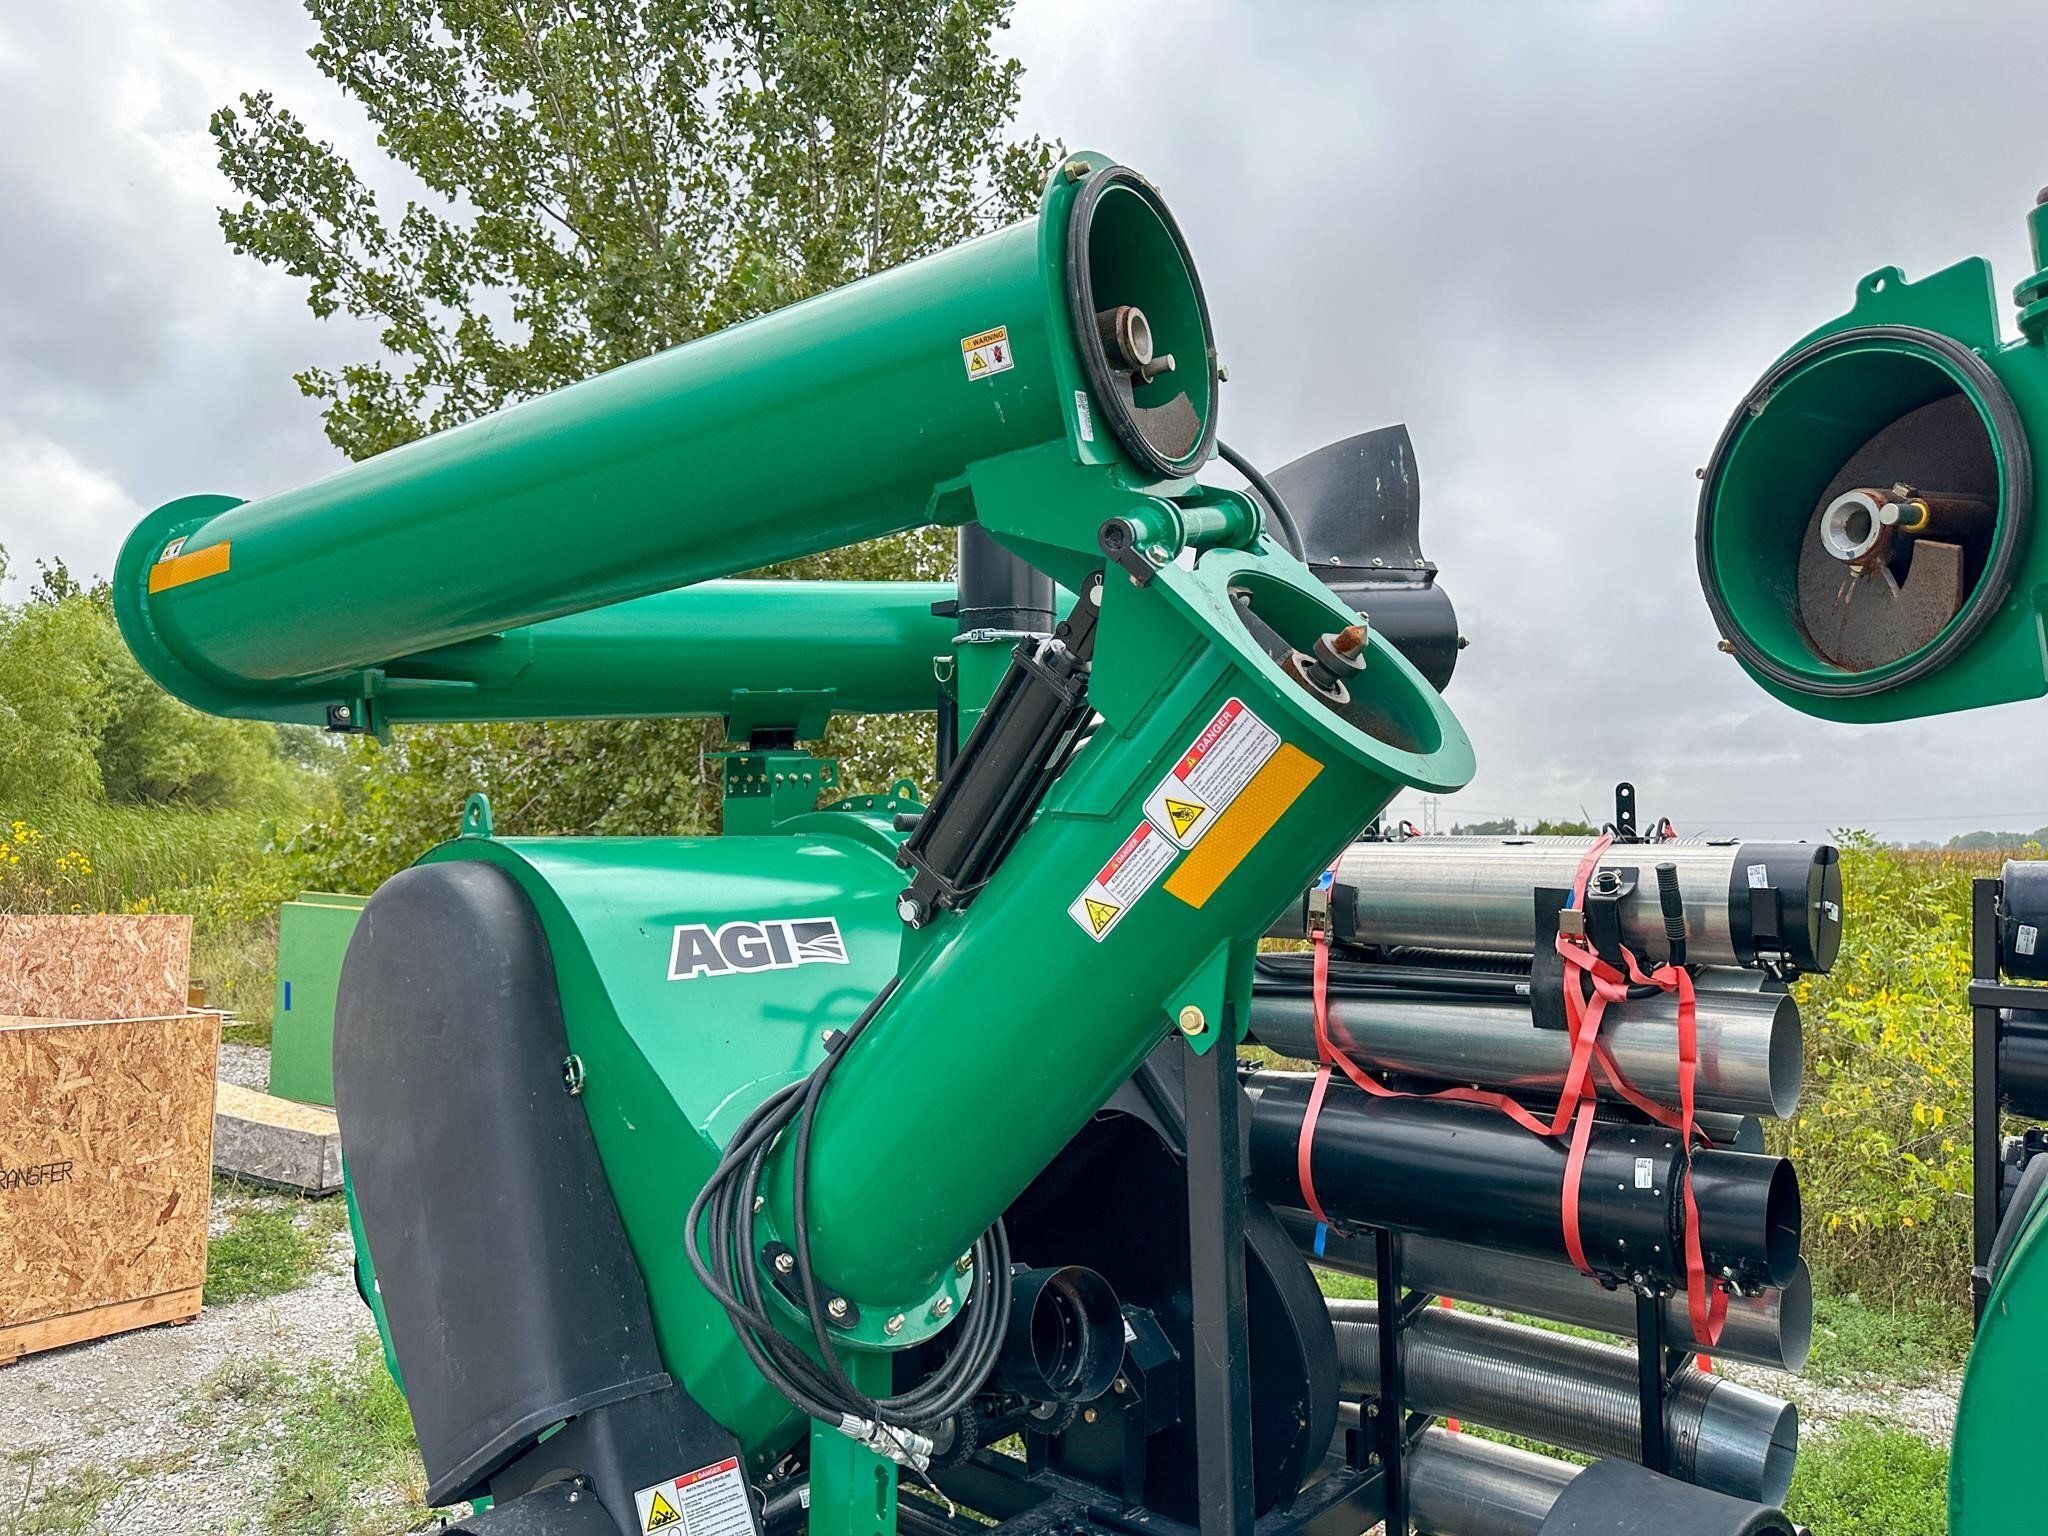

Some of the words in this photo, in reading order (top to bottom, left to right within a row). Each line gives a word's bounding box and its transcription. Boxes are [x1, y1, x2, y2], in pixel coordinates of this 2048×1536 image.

[972, 331, 1004, 346] WARNING
[1197, 711, 1232, 753] DANGER
[1116, 838, 1139, 864] DANGER
[674, 924, 794, 975] AGI
[697, 1466, 721, 1479] DANGER
